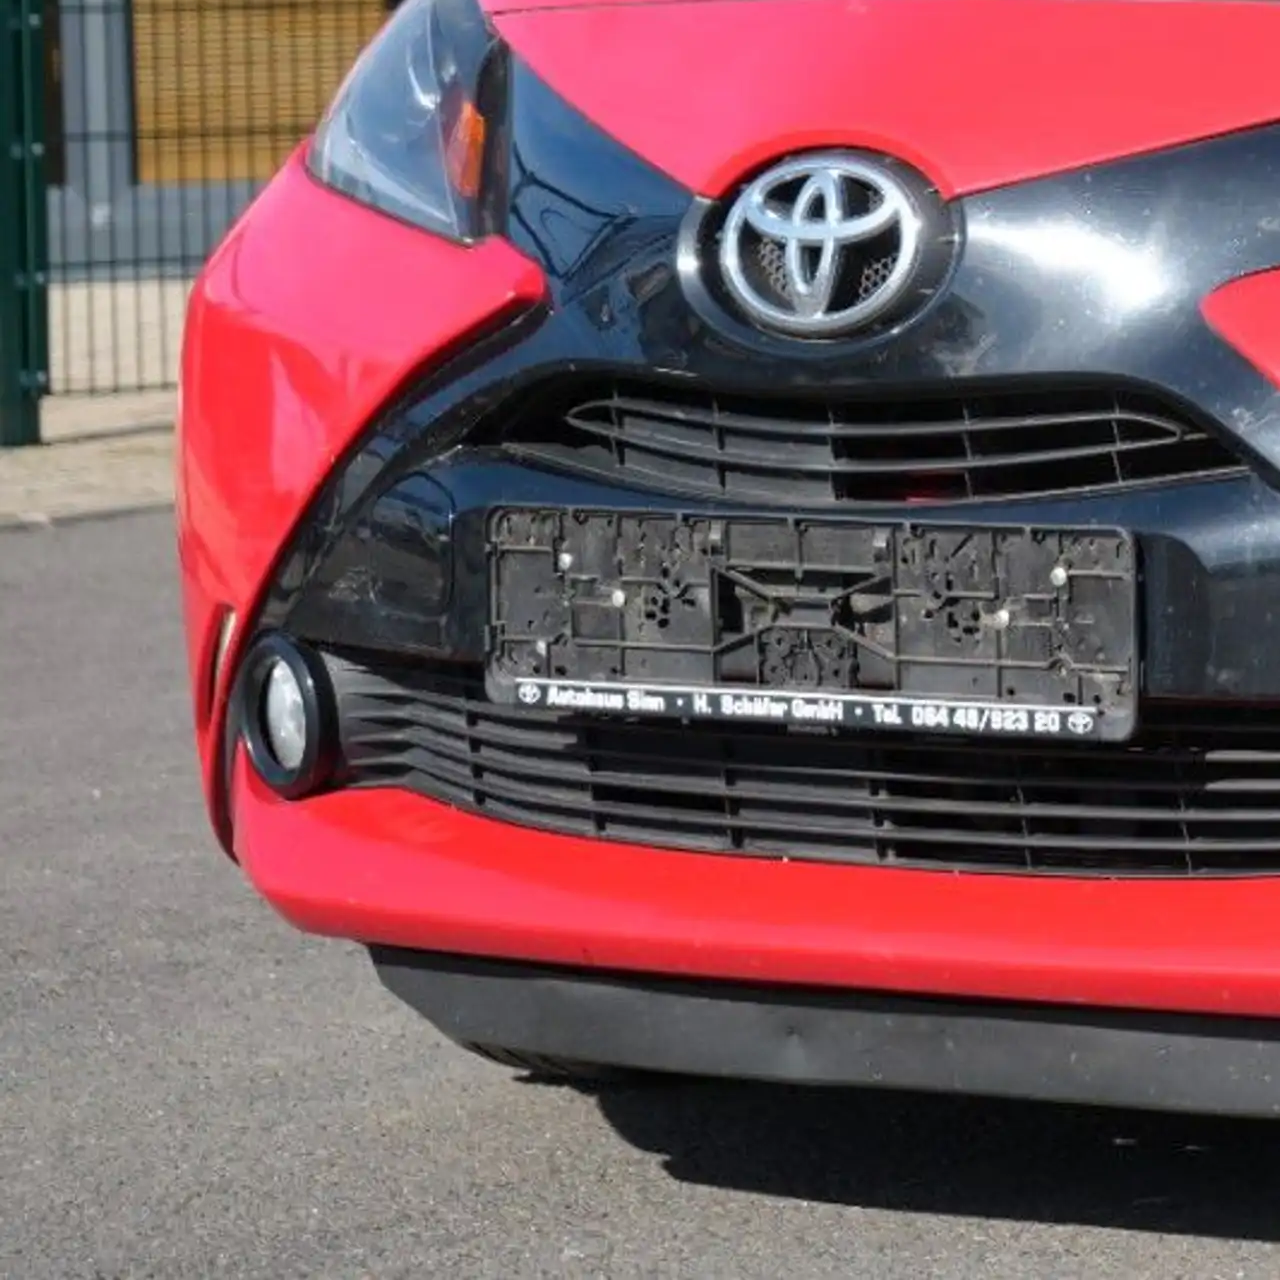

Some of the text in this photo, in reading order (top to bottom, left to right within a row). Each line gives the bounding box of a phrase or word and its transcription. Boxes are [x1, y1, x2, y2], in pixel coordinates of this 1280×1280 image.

[546, 685, 625, 710] Autohaus
[693, 694, 712, 714] H.
[791, 698, 844, 722] GmbH
[871, 703, 902, 725] Tel.
